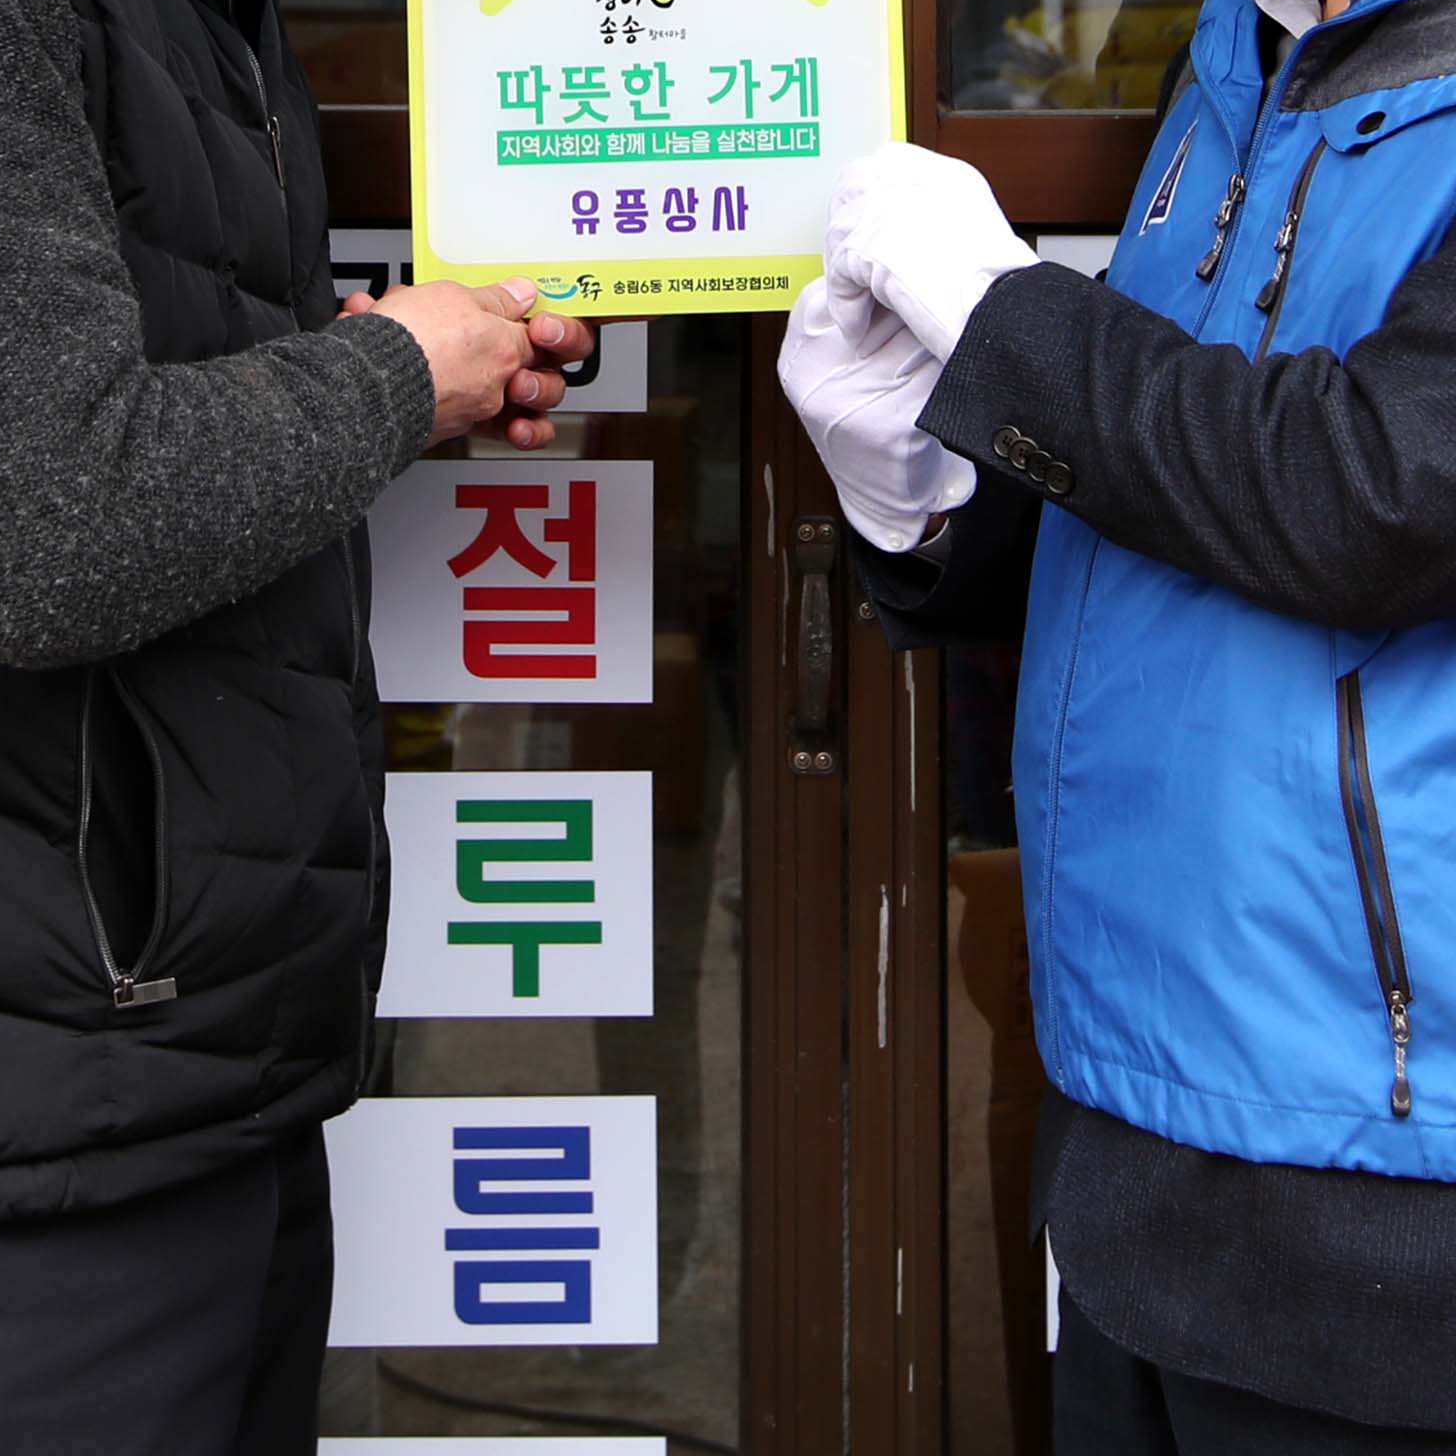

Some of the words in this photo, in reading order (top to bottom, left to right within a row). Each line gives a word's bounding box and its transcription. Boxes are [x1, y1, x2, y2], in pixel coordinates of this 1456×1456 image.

[600, 15, 646, 44] 송송
[497, 62, 674, 124] 따뜻한
[708, 57, 819, 119] 가게
[502, 135, 601, 158] 지역사회와
[606, 134, 645, 155] 함께
[651, 131, 712, 153] 나눔을
[716, 128, 816, 152] 실천합니다
[572, 186, 748, 235] 유풍상사
[614, 279, 662, 294] 송림6동
[668, 276, 789, 293] 지역사회보장협의체
[448, 481, 598, 680] 절
[447, 800, 602, 997] 루
[445, 1126, 600, 1325] 름
